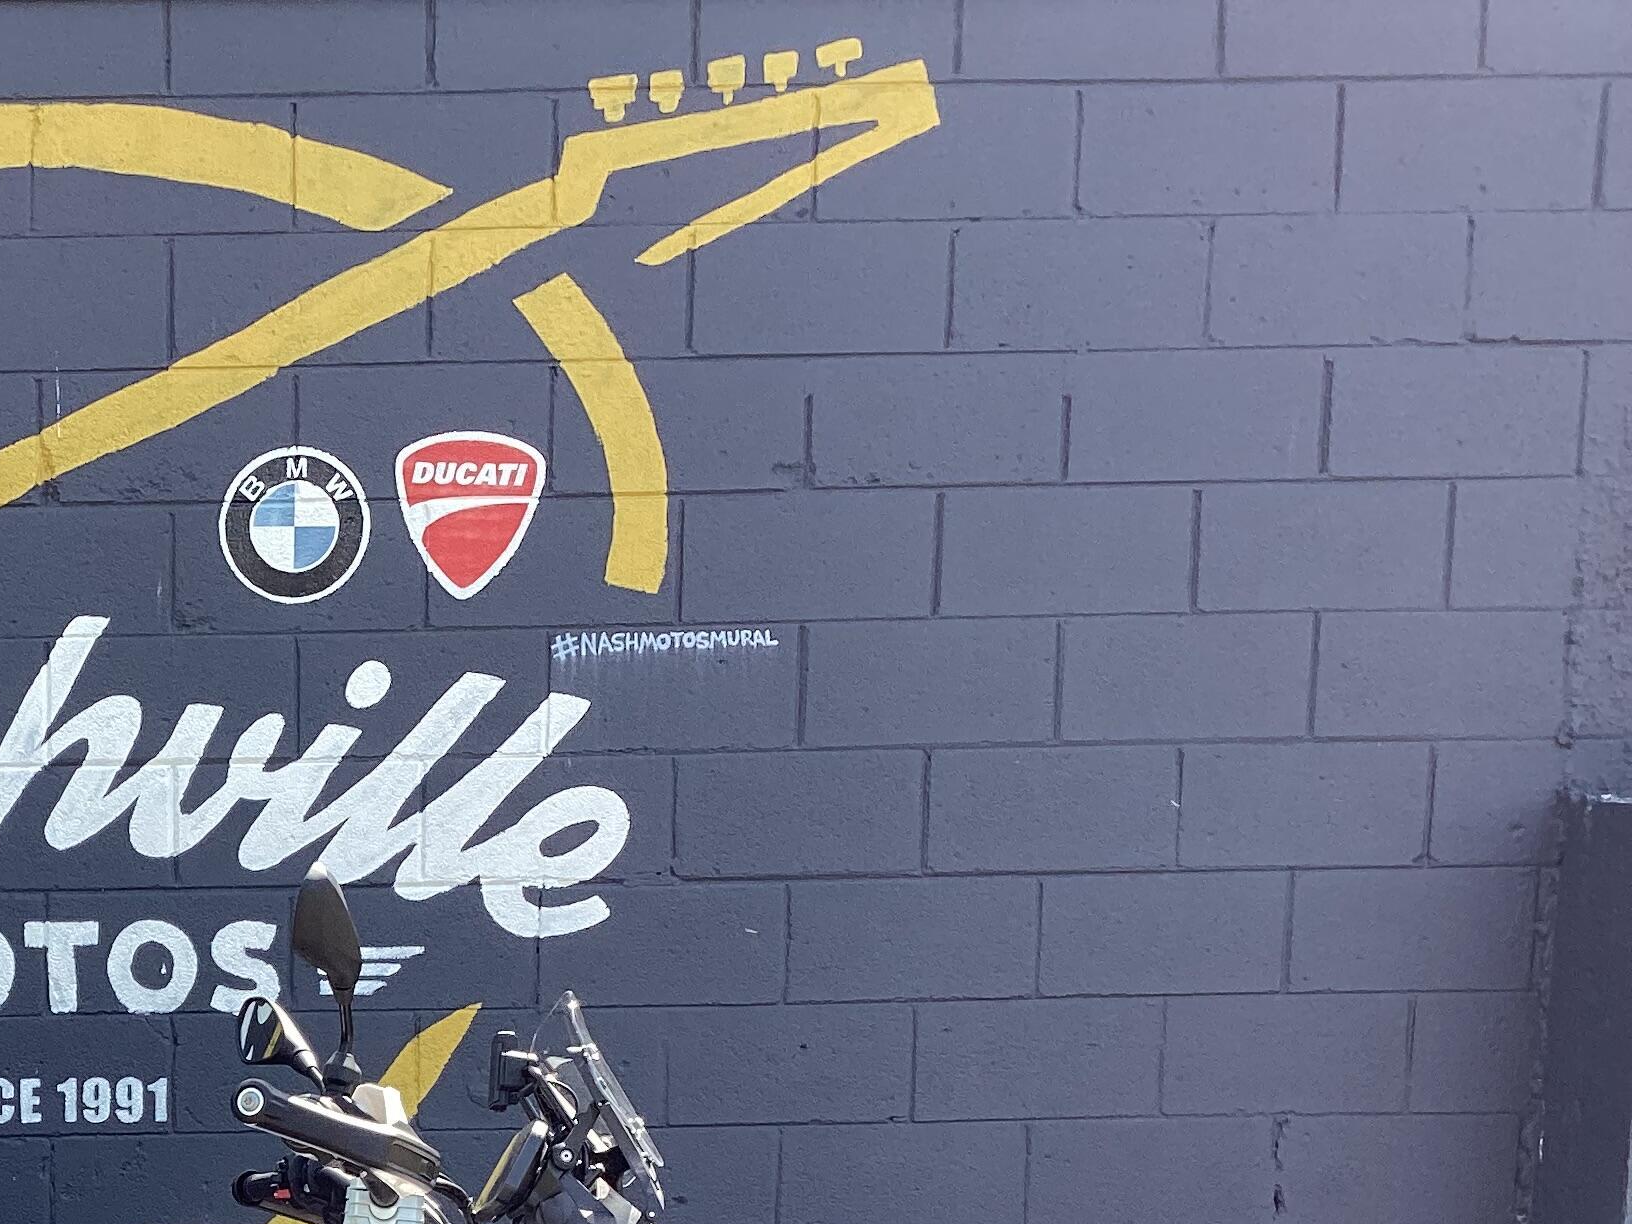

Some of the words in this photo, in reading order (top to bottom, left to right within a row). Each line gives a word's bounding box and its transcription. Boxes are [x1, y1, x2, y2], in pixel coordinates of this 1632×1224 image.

[239, 457, 354, 502] BMW
[411, 461, 529, 488] DUCATI
[550, 629, 780, 661] #NASHMOTOSMURAL
[56, 1076, 169, 1125] 1991
